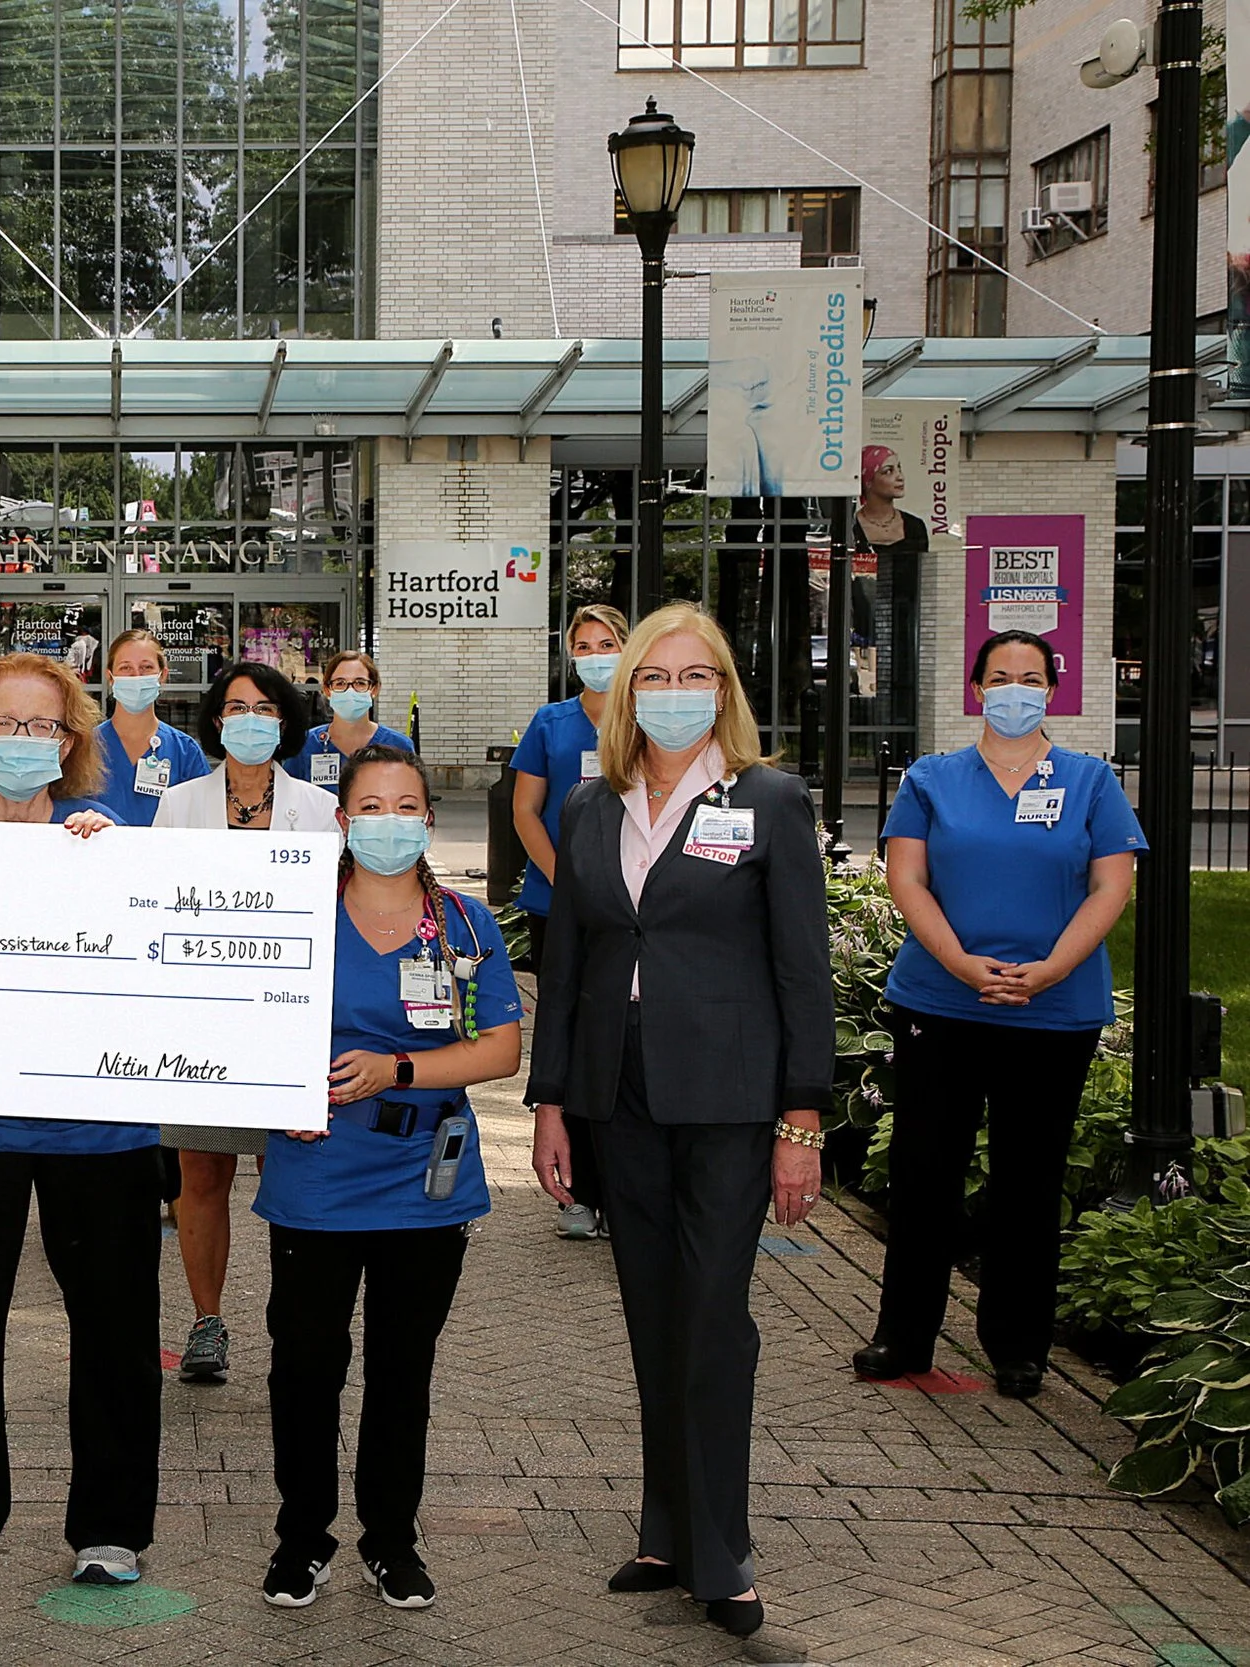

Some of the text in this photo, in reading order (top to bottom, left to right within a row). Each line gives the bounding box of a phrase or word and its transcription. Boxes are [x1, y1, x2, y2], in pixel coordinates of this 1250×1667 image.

[729, 297, 764, 306] Hartford
[806, 349, 819, 416] The future of
[819, 292, 851, 471] Orthopedics
[928, 414, 952, 535] More hope.
[69, 540, 286, 565] ENTRANCE
[994, 551, 1054, 570] BEST
[388, 570, 499, 592] Hartford
[994, 571, 1054, 584] REGIONAL HOSPITALS
[388, 596, 498, 624] Hospital
[16, 619, 62, 630] Hartford
[148, 618, 194, 630] Hartford
[16, 630, 61, 643] Hospital
[27, 646, 61, 655] Seymour
[194, 647, 218, 655] Street
[269, 849, 311, 864] 1935
[684, 844, 736, 864] DOCTOR
[129, 897, 158, 908] Date
[174, 886, 202, 917] July
[76, 931, 112, 955] Fund
[147, 938, 282, 961] $ $25,000.00
[263, 991, 310, 1003] Dollars
[96, 1052, 227, 1080] Nitin Mhatre
